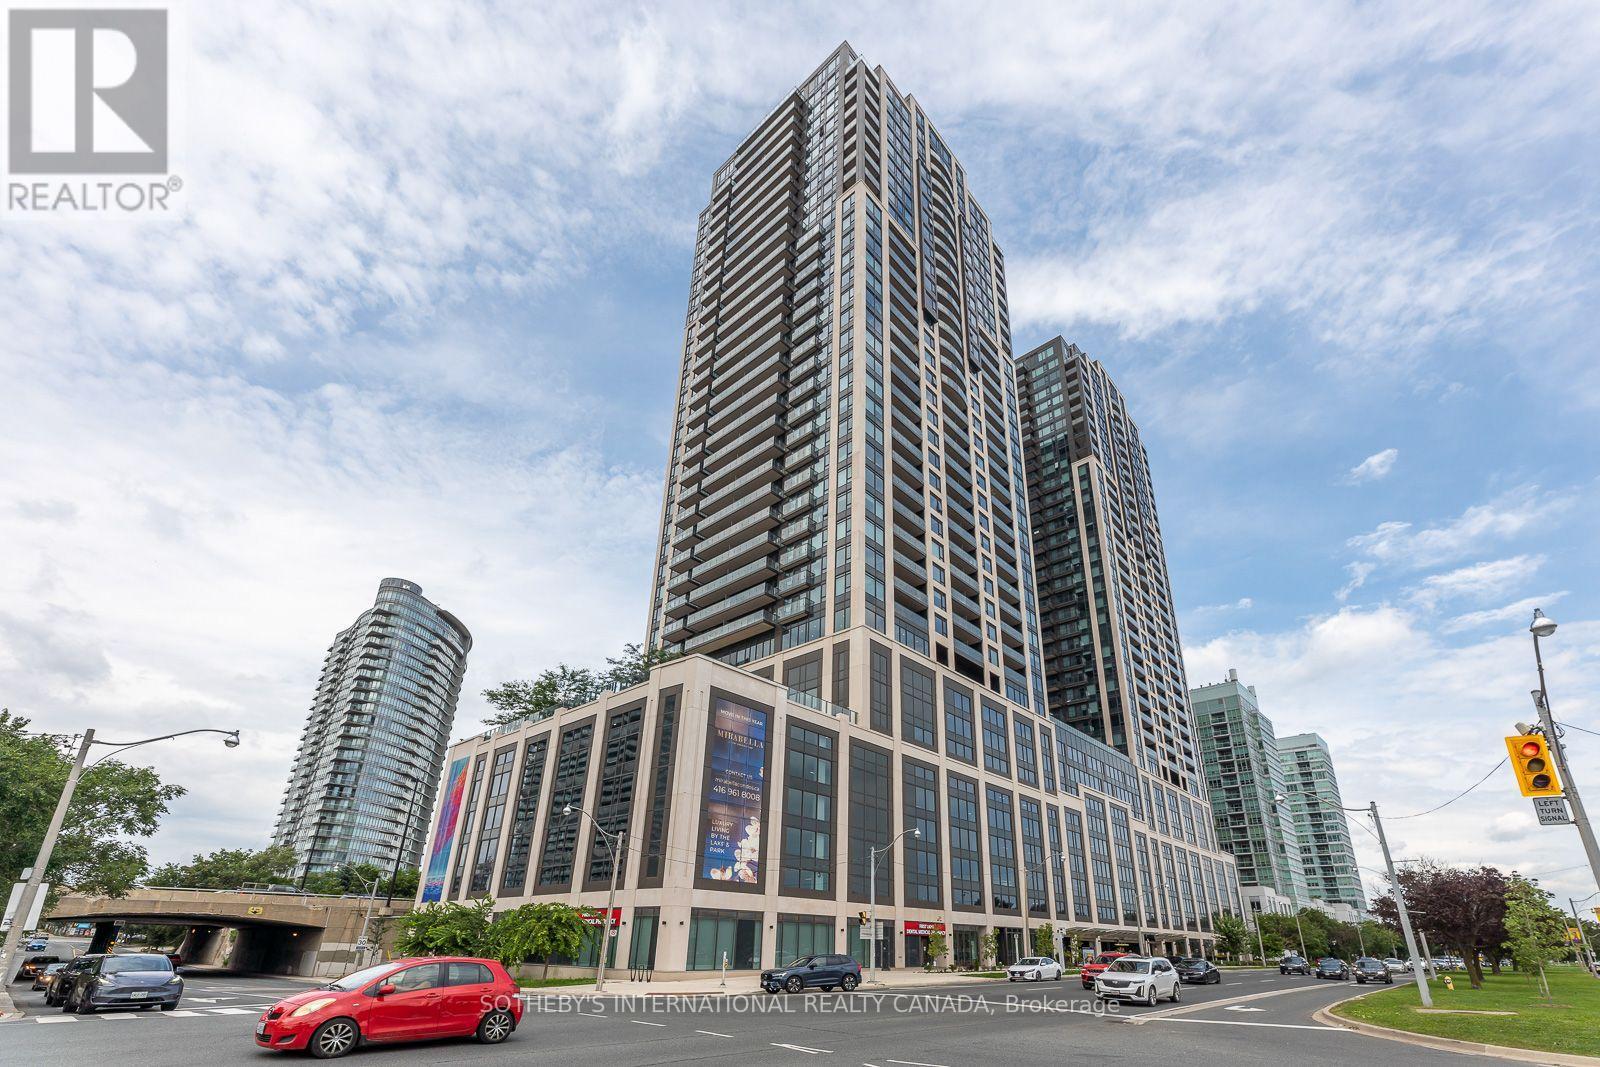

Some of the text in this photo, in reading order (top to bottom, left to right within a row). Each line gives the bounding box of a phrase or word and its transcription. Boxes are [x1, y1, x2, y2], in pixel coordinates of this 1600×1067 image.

[720, 709, 734, 717] MOVE
[718, 729, 764, 748] MIRABELLA
[726, 770, 746, 778] CONTACT
[713, 785, 761, 802] 416 961 8008
